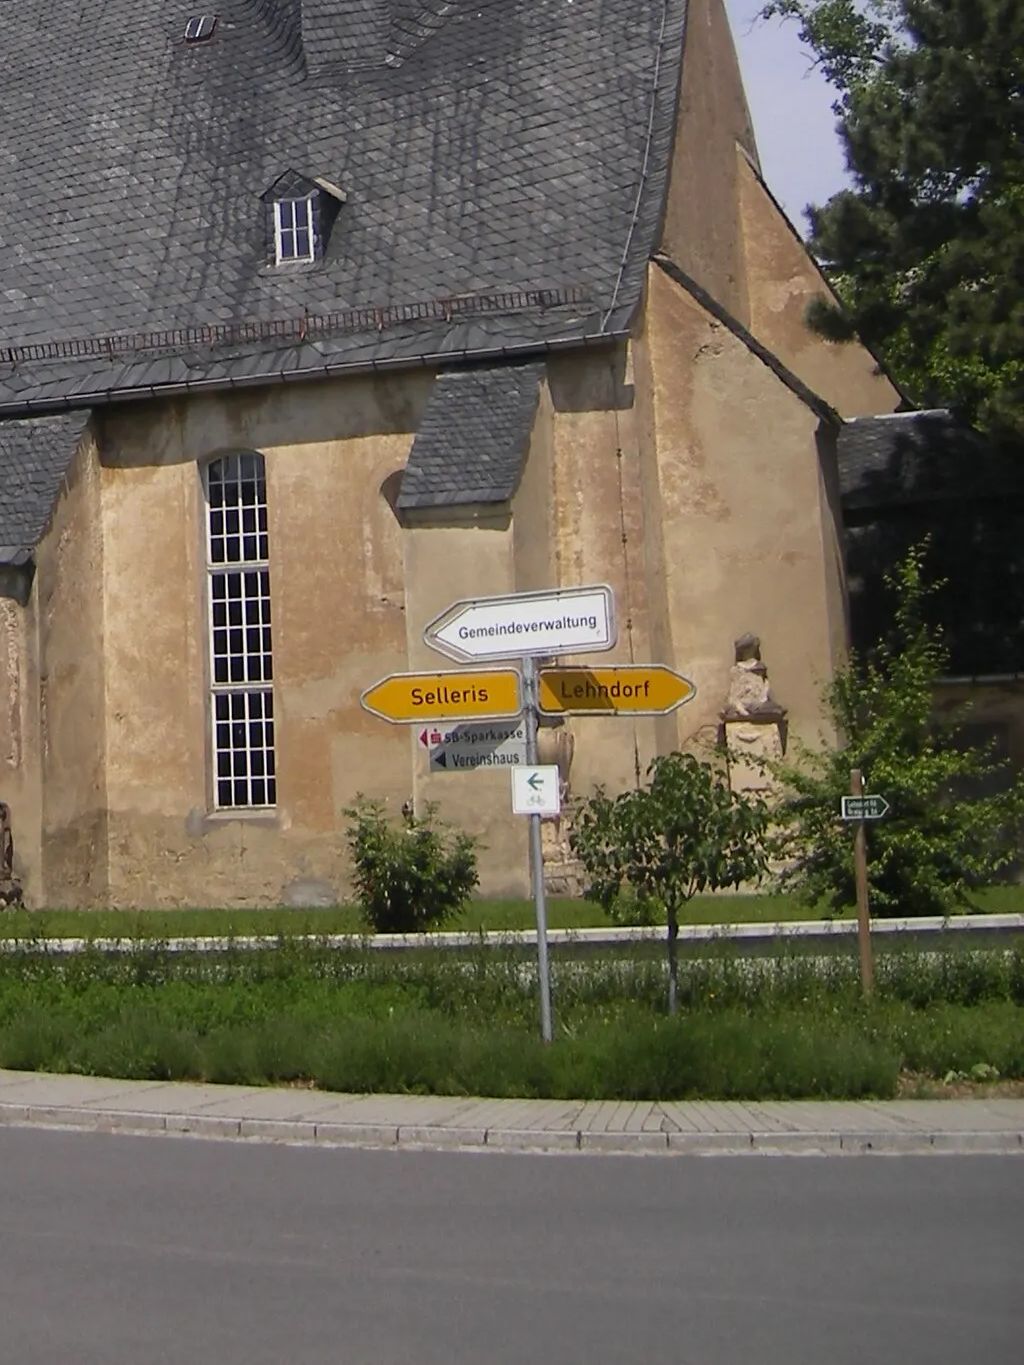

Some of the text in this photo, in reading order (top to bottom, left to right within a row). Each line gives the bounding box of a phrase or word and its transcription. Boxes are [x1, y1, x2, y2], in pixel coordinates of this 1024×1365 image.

[458, 615, 597, 639] Gemeindeverwaltung
[411, 685, 488, 705] Selleris
[561, 680, 650, 698] Lehndorf
[444, 729, 523, 744] SB-Sparkasse
[452, 753, 520, 767] Vereinshaus
